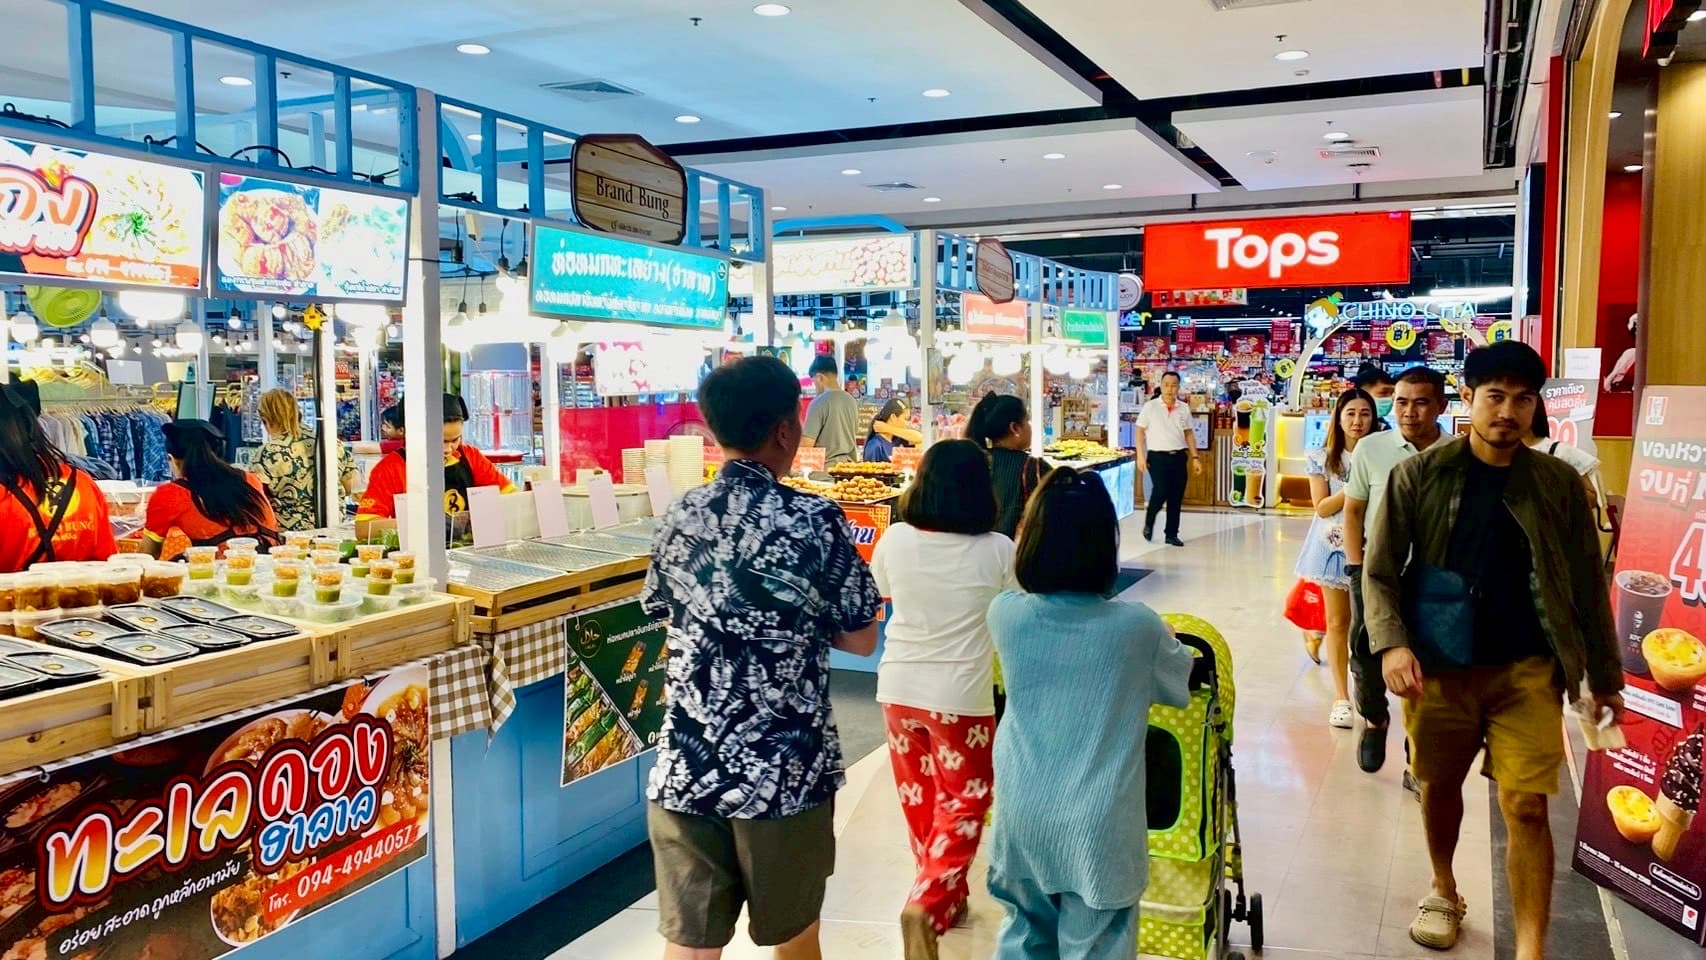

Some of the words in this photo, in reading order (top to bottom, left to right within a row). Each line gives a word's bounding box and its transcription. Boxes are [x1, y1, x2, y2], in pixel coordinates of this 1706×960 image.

[595, 175, 634, 204] Brand
[639, 186, 669, 220] Bung
[1204, 228, 1340, 278] Tops
[1341, 302, 1417, 321] CHINO
[1545, 383, 1585, 398] ราคาเดียว
[1640, 469, 1692, 504] จบที่
[47, 722, 389, 903] ทะเลดอง
[258, 786, 376, 866] ฮาลาล
[268, 892, 292, 913] โทร.
[296, 824, 413, 898] 094-4944057
[58, 924, 102, 955] อร่อย
[103, 903, 151, 937] สะอาด
[151, 859, 241, 920] ถูกหลักอนามัย
